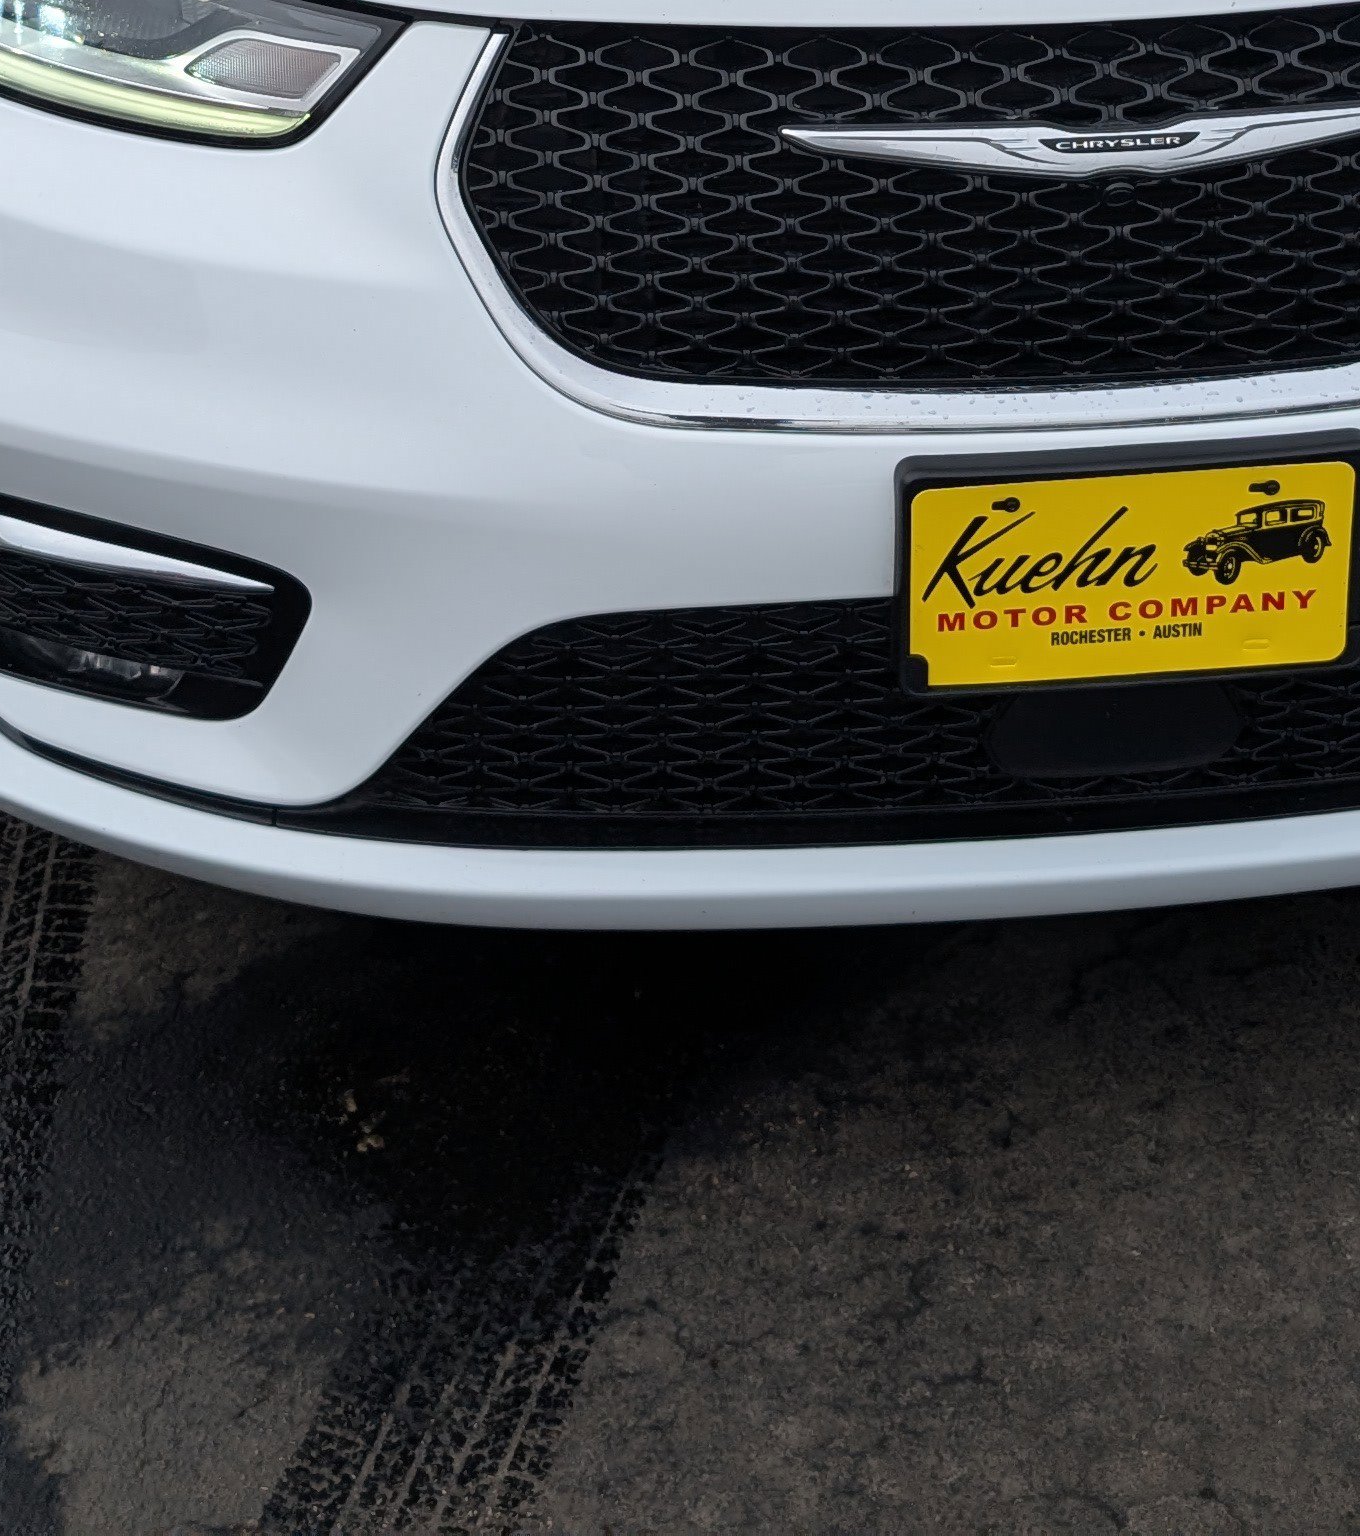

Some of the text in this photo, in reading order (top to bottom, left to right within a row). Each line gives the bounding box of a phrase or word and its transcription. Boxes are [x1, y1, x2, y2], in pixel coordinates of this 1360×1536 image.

[1055, 136, 1181, 150] CHRYSLER
[921, 505, 1159, 610] Kuehn
[937, 589, 1318, 633] MOTOR COMPANY
[1050, 622, 1203, 646] ROCHESTER AUSTIN
